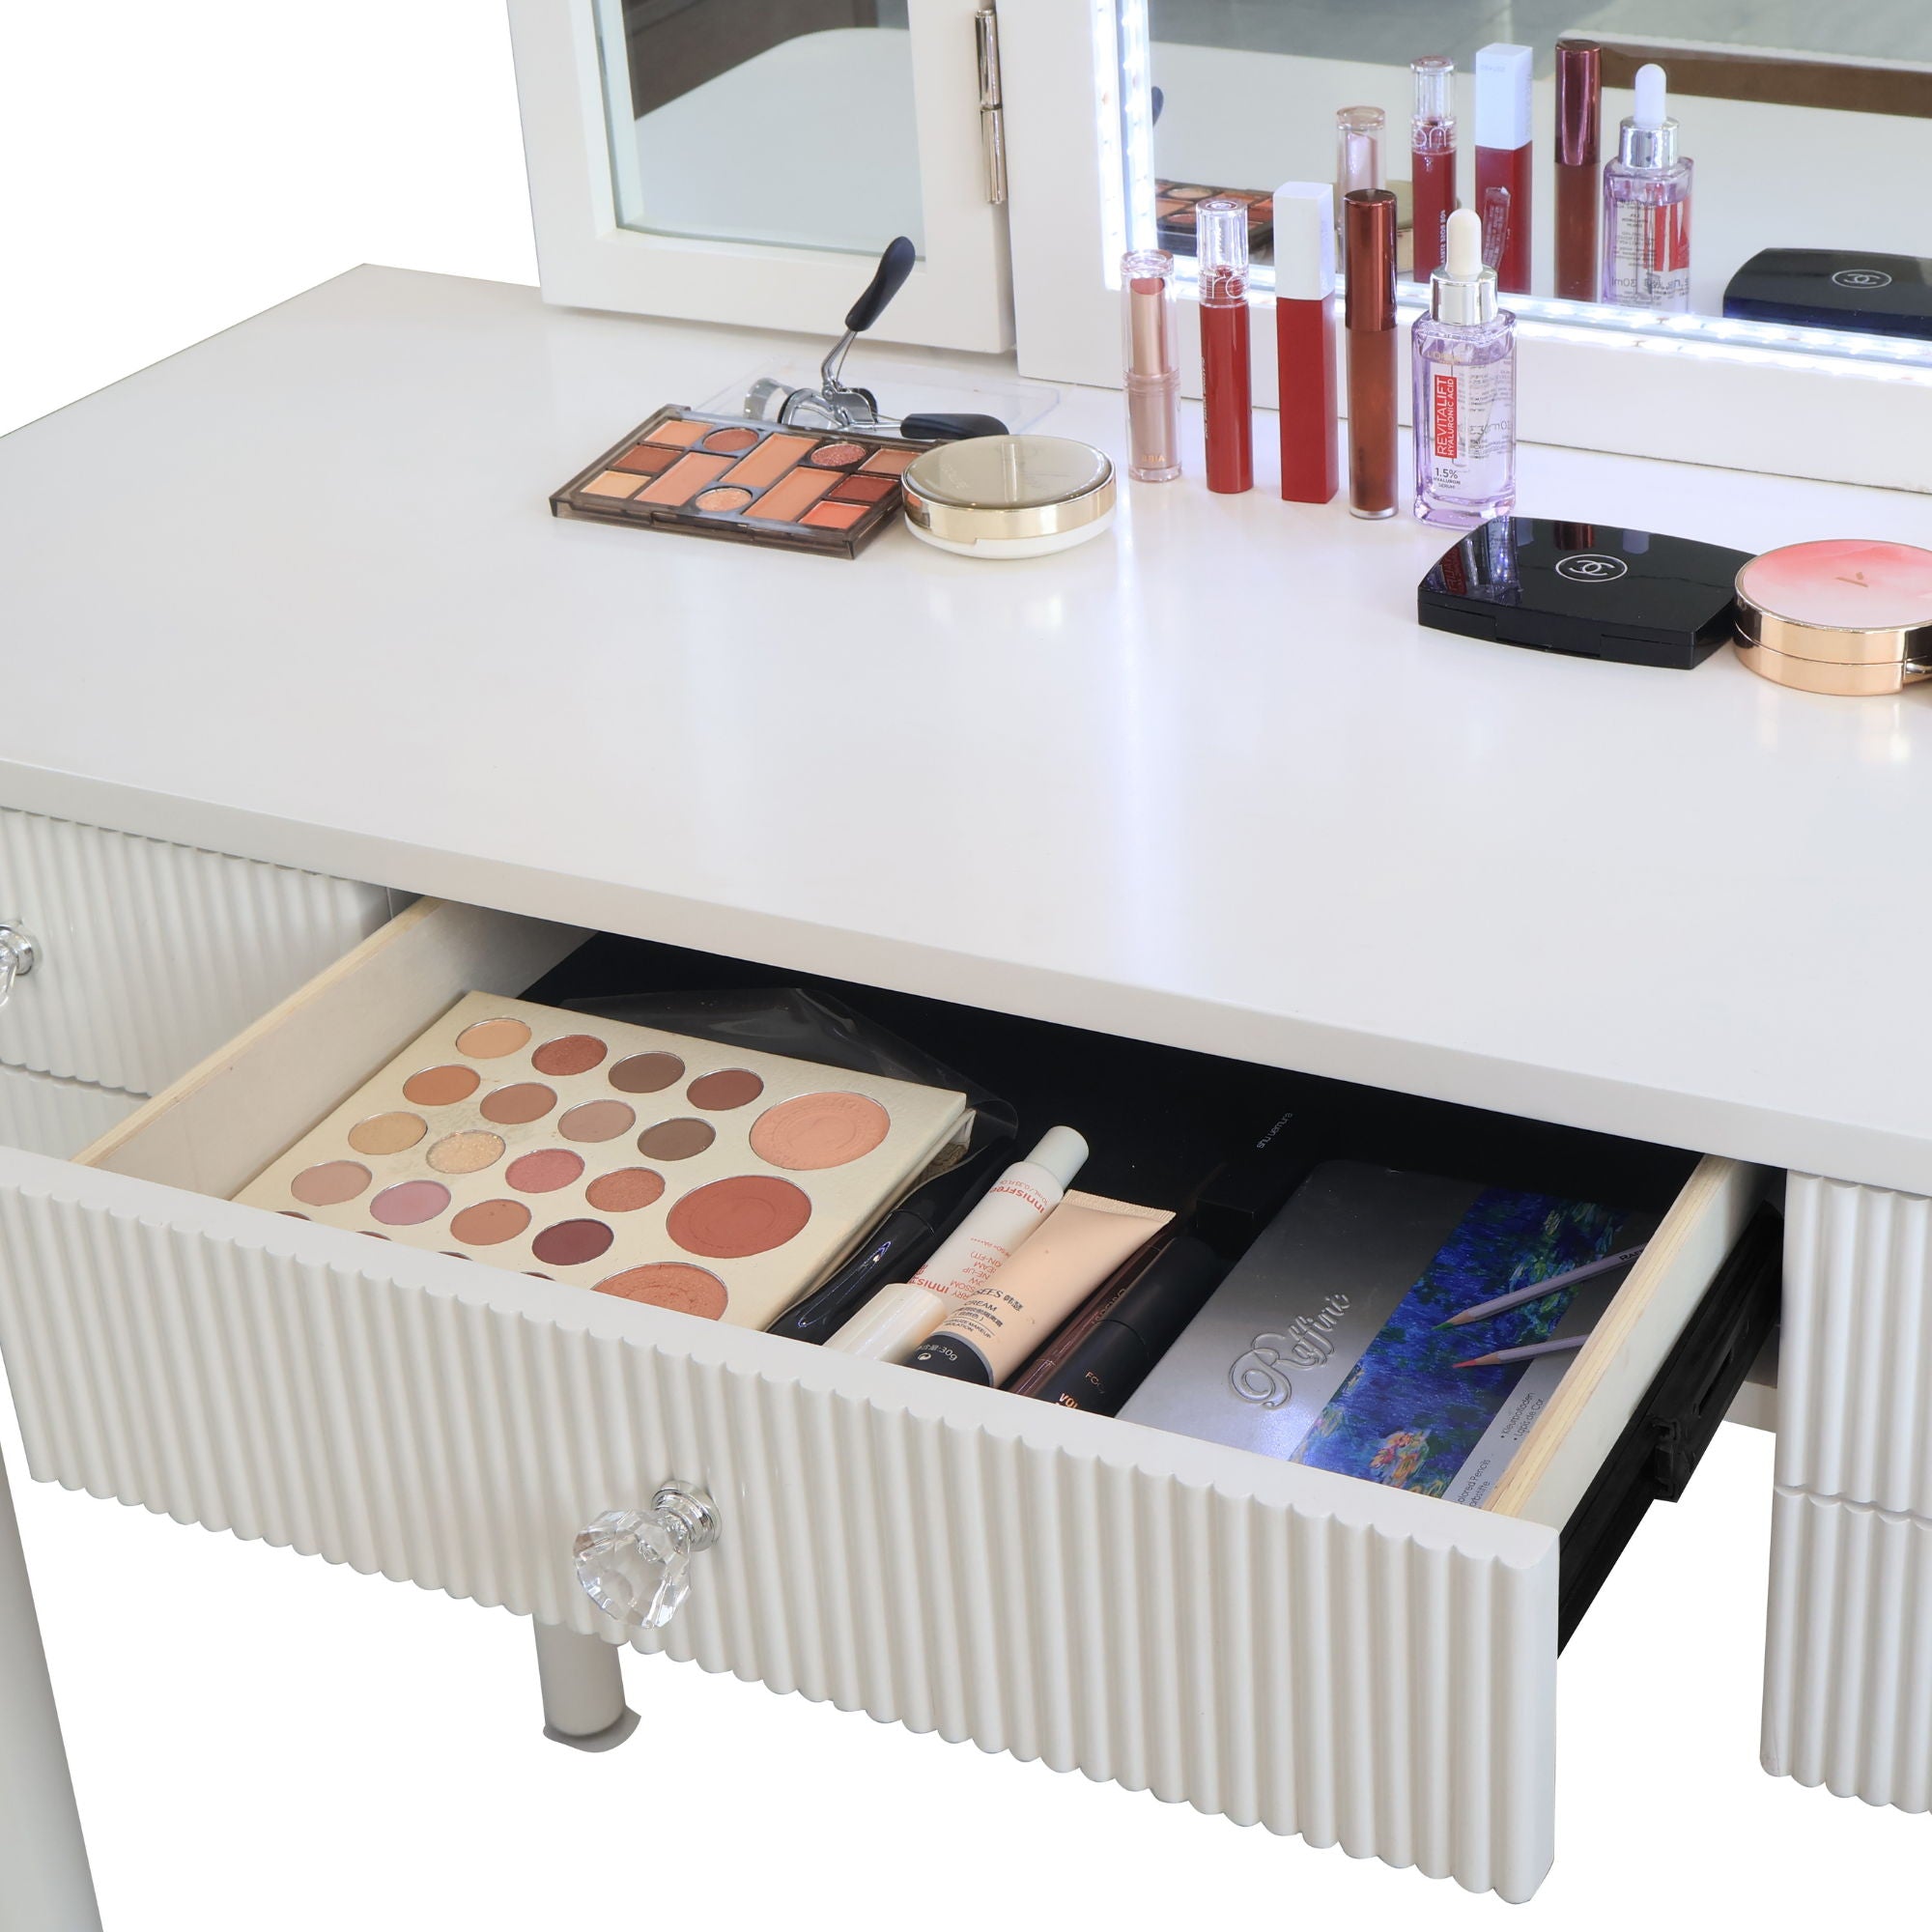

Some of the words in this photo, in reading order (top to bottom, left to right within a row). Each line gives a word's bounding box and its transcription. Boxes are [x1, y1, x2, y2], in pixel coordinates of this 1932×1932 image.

[1446, 379, 1455, 400] ACID
[1436, 377, 1448, 455] REVITALIFT
[1446, 401, 1455, 456] HYALURONIC
[1435, 468, 1459, 479] 1.5%
[962, 1267, 991, 1280] NE-UP
[974, 1261, 998, 1275] EAM
[951, 1279, 976, 1293] SSOM
[952, 1291, 971, 1300] RRY
[1457, 1482, 1477, 1504] olored
[1468, 1481, 1491, 1508] arbstifte
